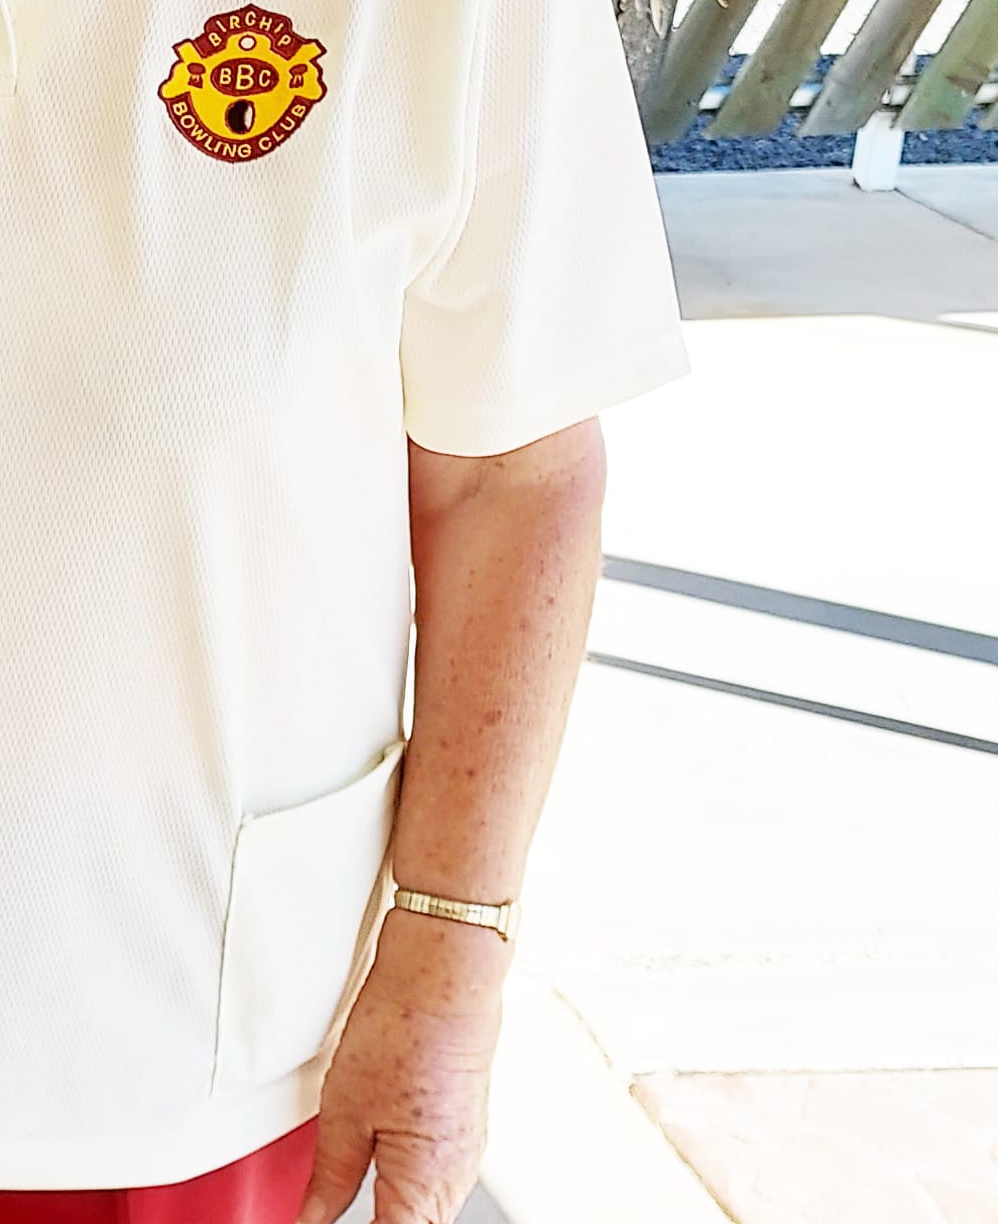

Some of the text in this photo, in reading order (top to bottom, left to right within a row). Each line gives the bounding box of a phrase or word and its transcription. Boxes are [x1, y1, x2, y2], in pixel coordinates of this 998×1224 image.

[208, 11, 292, 47] BIRCHIP
[219, 64, 272, 91] BBC
[172, 101, 307, 158] BOWLING CLUB
